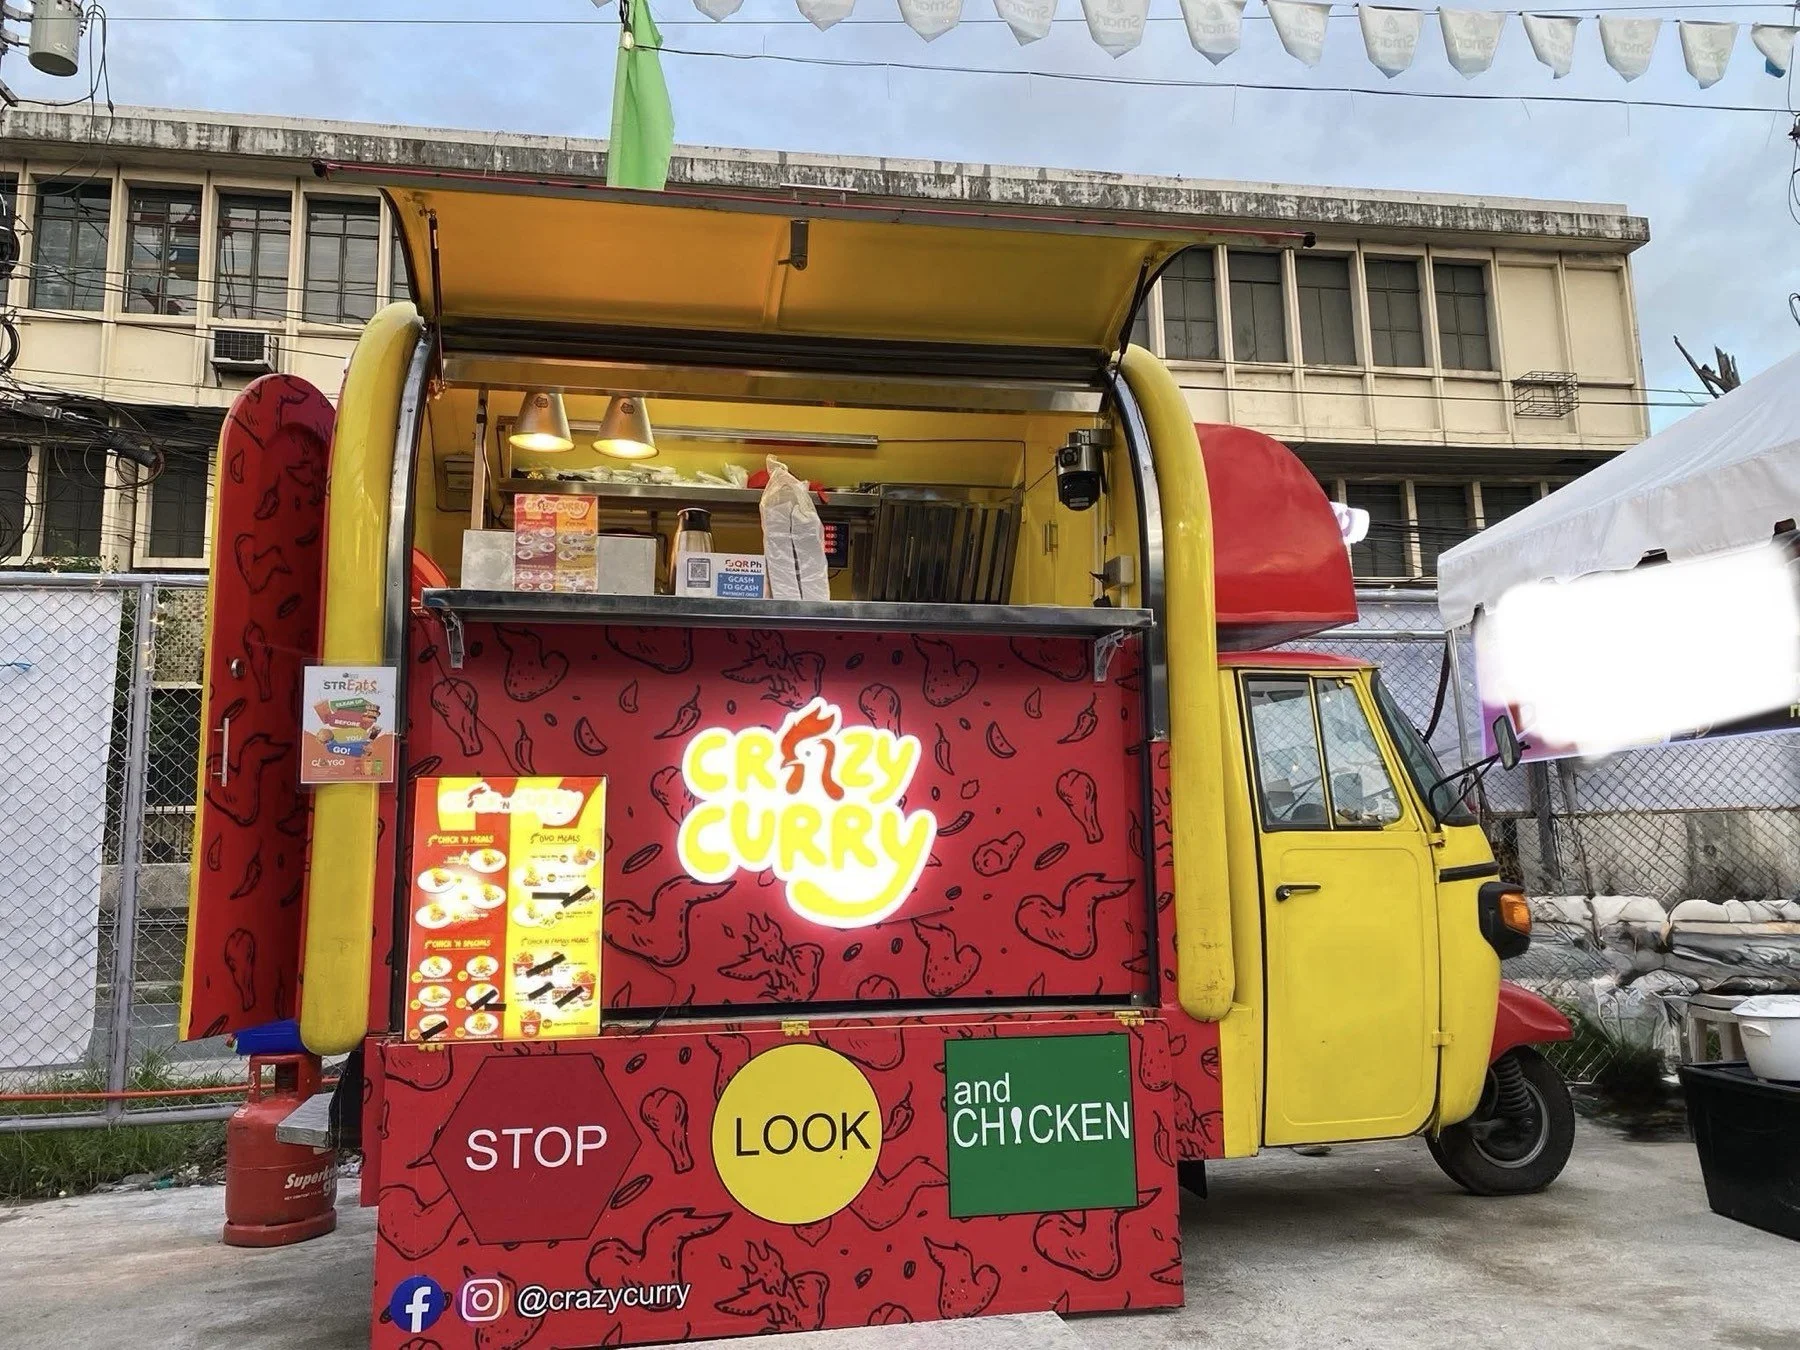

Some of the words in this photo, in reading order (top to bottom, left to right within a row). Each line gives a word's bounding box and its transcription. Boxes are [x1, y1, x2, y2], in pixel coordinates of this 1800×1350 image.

[728, 575, 754, 583] GCASH
[734, 584, 759, 592] GCASH
[333, 746, 351, 755] GO!
[684, 800, 930, 920] CURRY
[953, 1072, 1011, 1105] and
[735, 1110, 871, 1157] LOOK
[953, 1101, 1130, 1148] CHICKEN
[465, 1125, 607, 1172] STOP
[518, 1283, 691, 1318] @crazycurry
